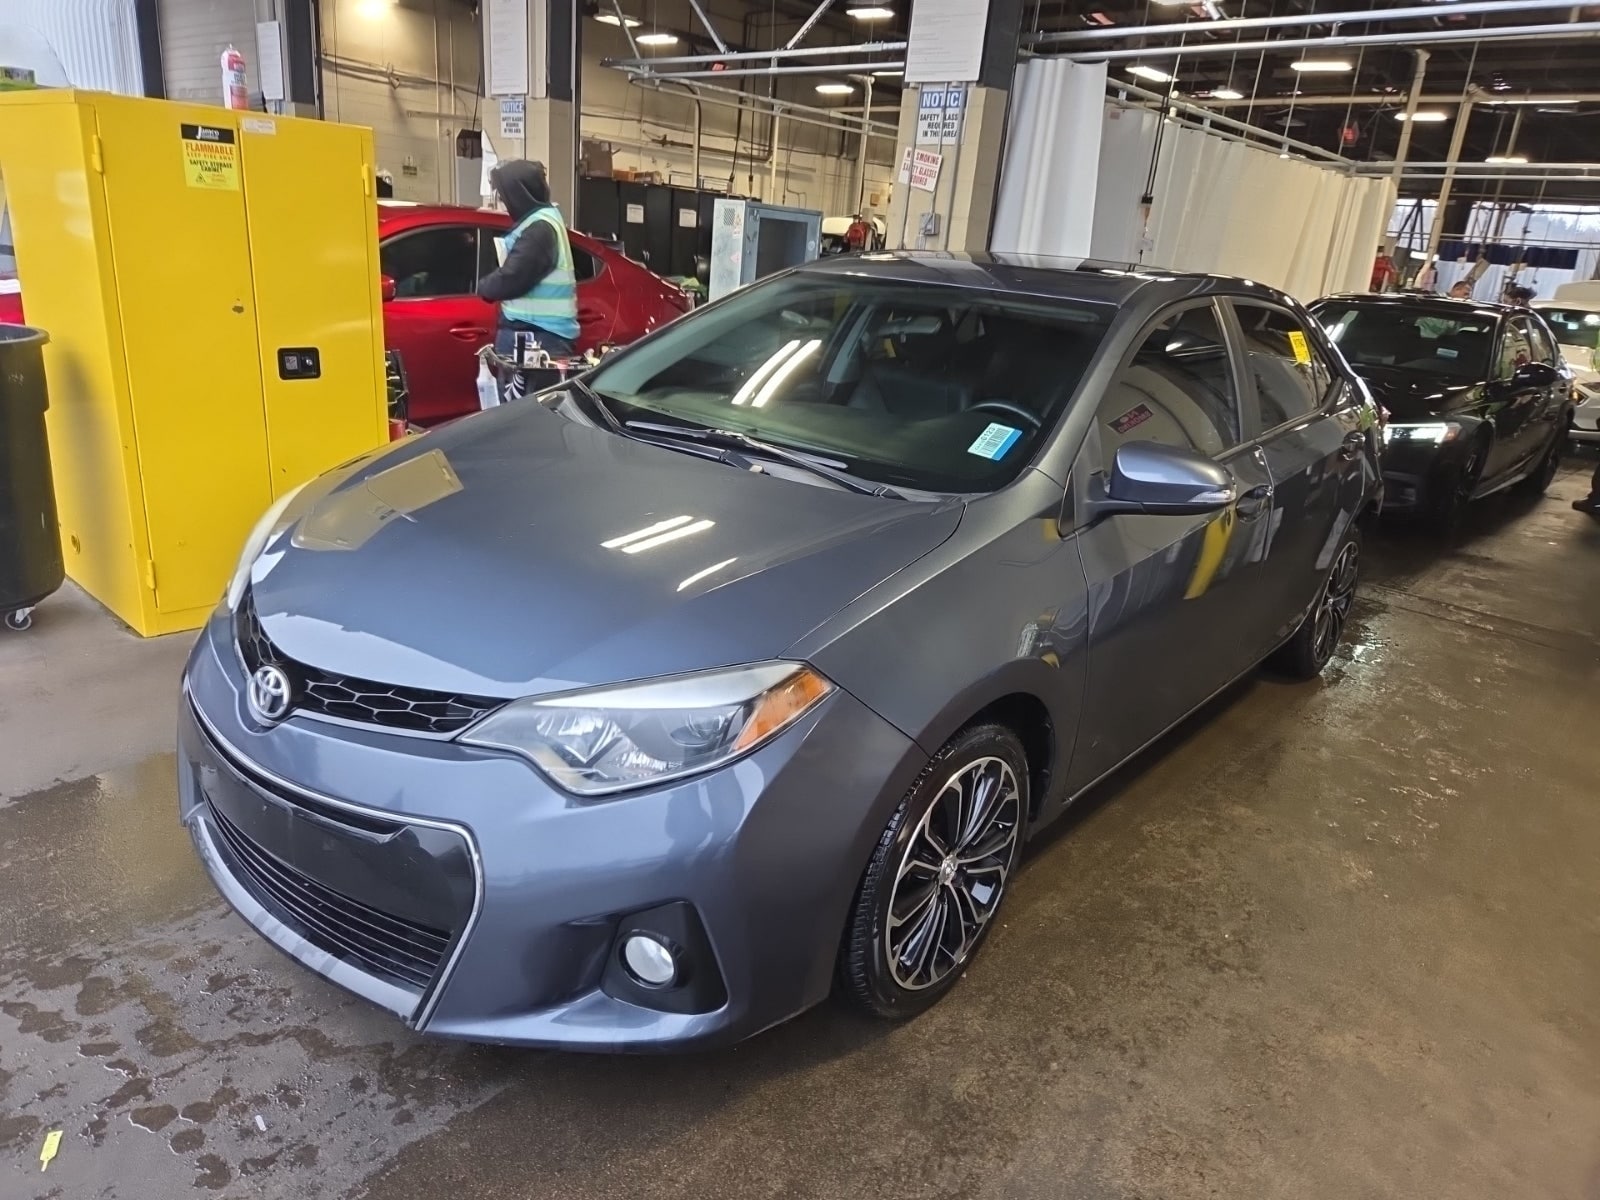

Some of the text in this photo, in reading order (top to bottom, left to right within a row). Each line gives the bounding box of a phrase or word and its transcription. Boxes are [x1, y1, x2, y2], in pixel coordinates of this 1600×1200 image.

[920, 113, 940, 121] SAFETY
[185, 141, 234, 156] FLAMMABLE
[189, 159, 208, 167] SAFETY
[915, 152, 940, 166] SMOKING
